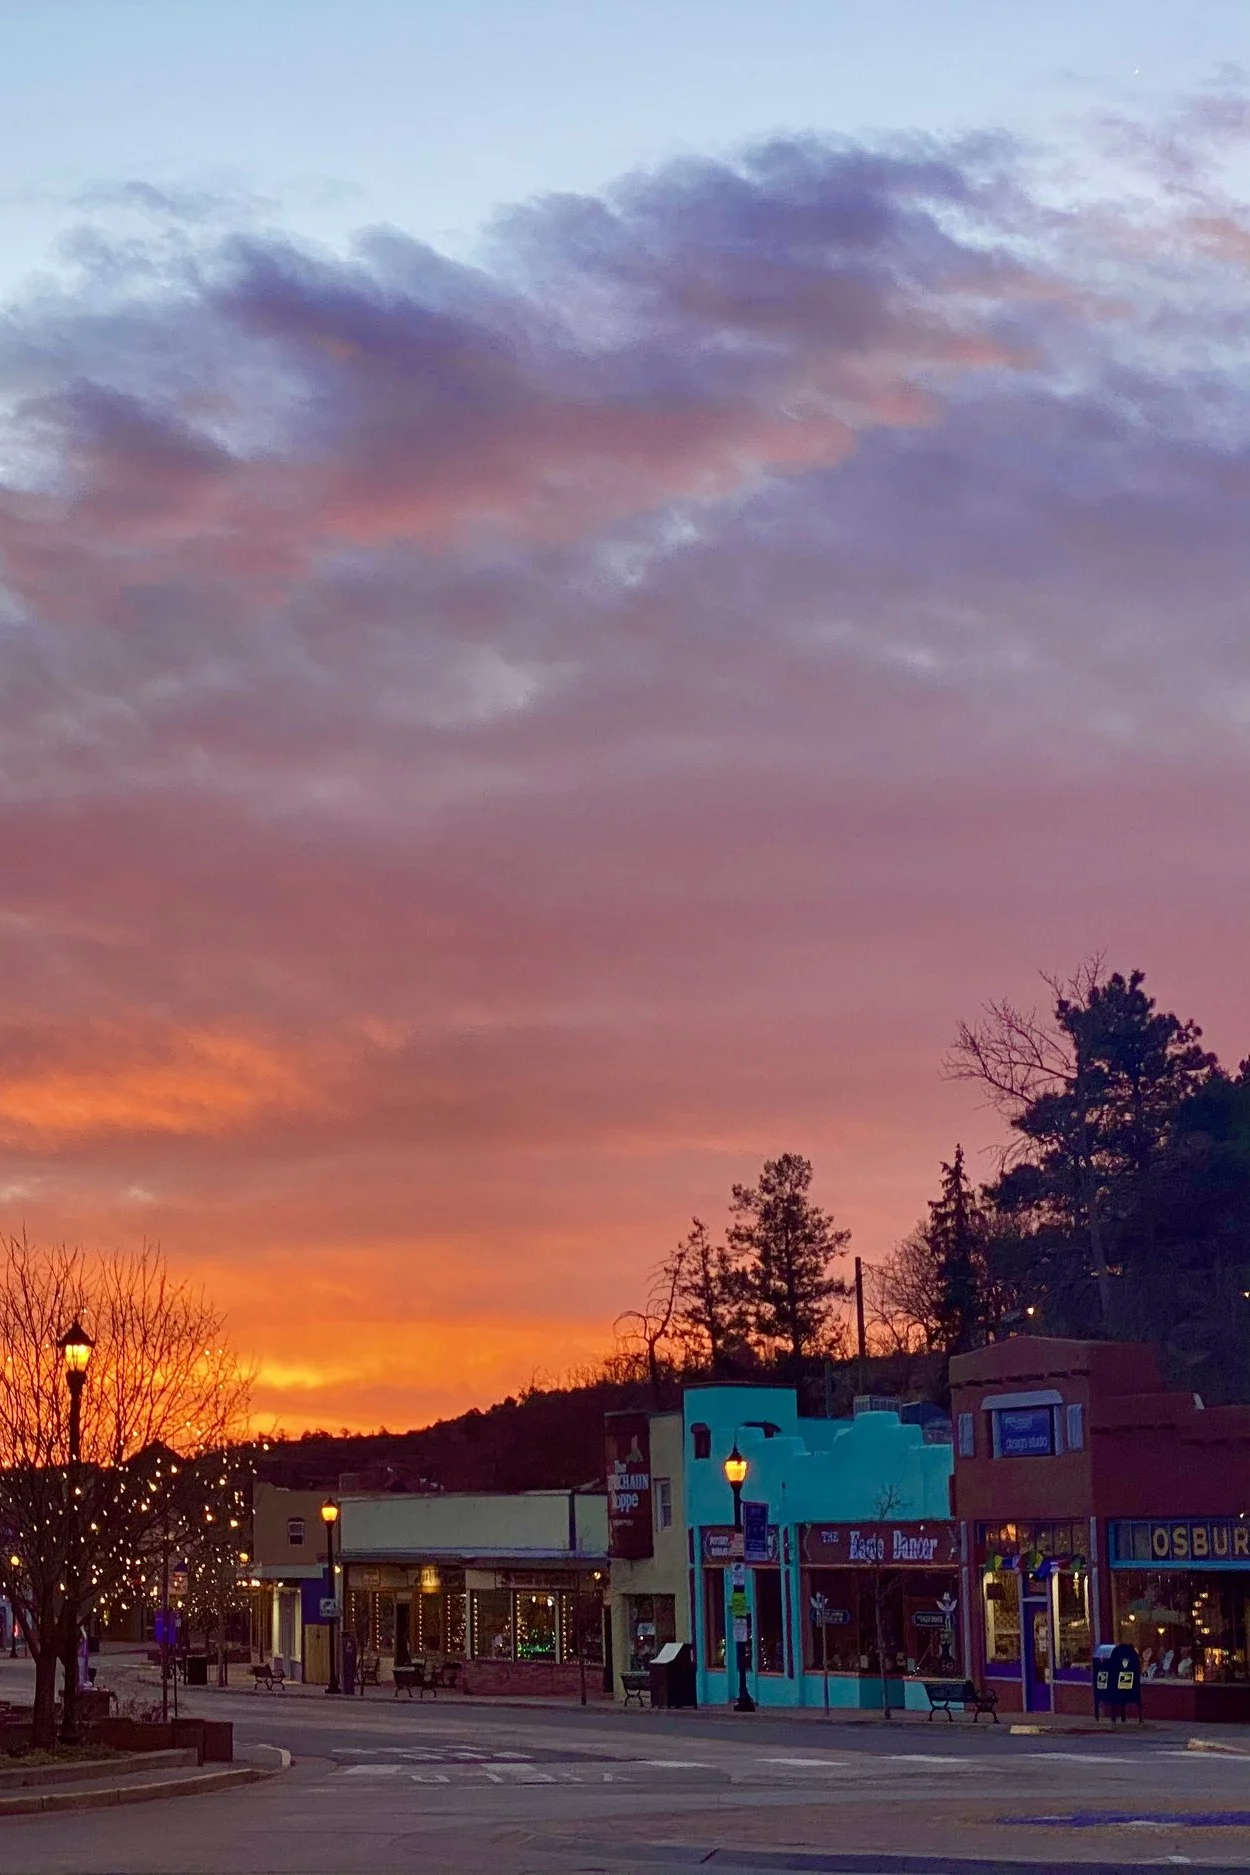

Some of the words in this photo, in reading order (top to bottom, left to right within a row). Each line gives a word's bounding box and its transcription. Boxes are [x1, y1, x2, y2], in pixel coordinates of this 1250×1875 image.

[1029, 1435, 1048, 1448] studio
[821, 1531, 839, 1543] THE
[849, 1530, 885, 1562] Eagle
[893, 1530, 938, 1560] Dancer
